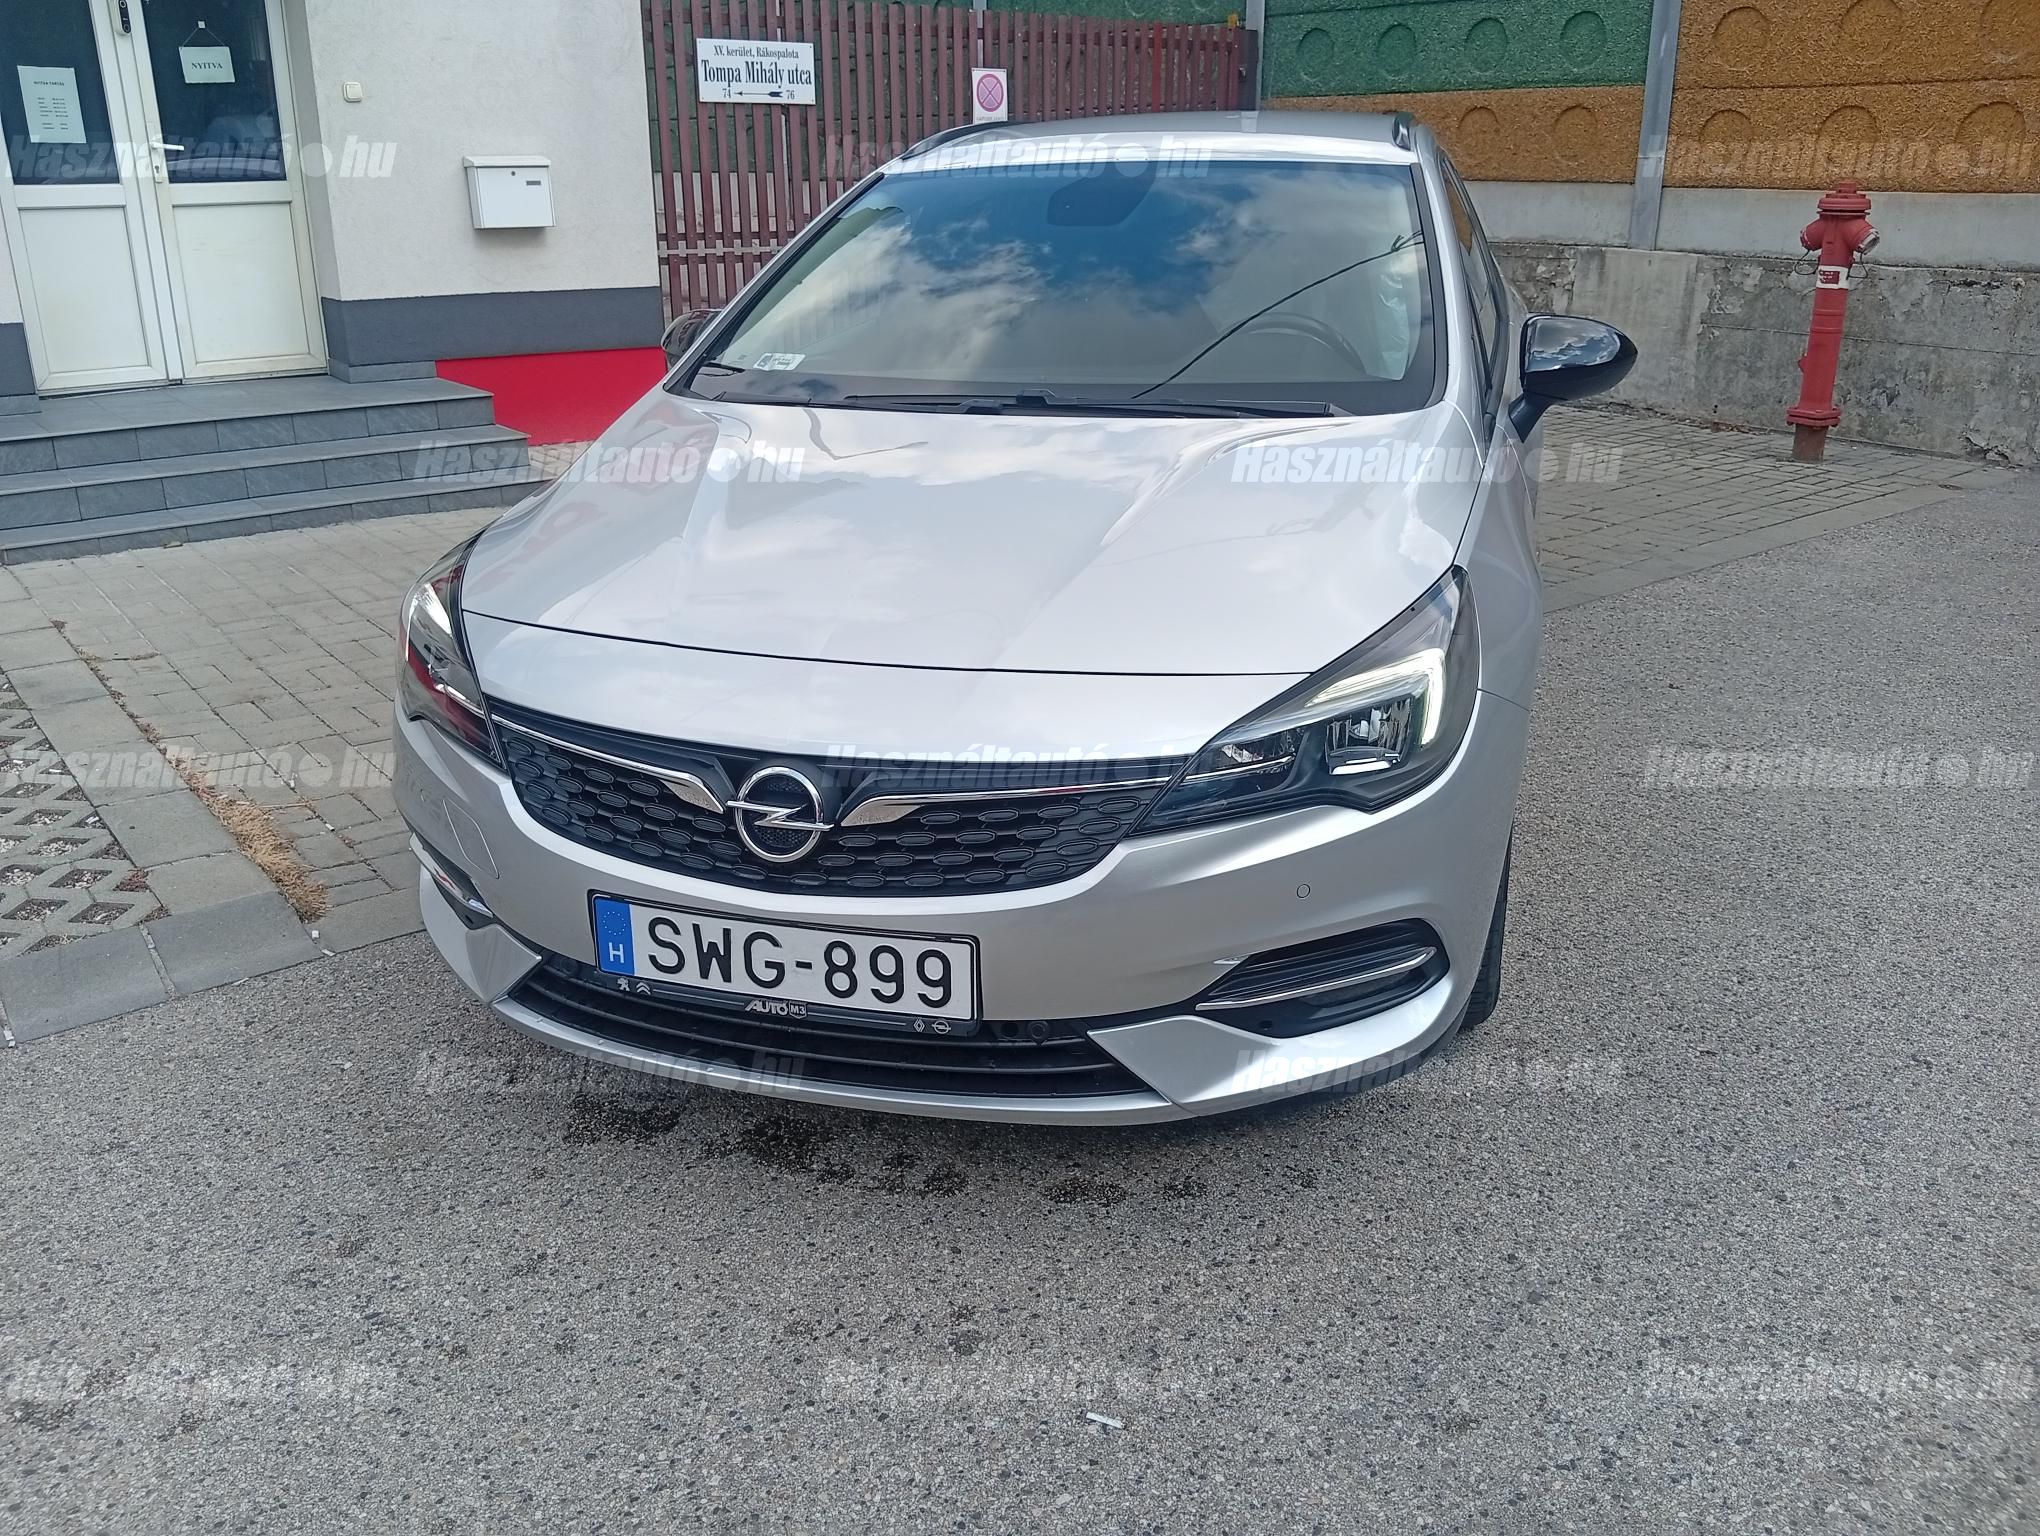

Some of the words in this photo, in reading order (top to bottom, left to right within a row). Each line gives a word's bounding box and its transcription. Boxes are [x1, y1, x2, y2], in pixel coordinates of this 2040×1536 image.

[713, 45, 725, 57] XV.
[726, 45, 755, 58] kerület,
[756, 46, 799, 60] Rákospalota
[701, 59, 742, 88] Tompa
[744, 61, 785, 89] Mihály
[787, 63, 812, 85] utca
[722, 88, 731, 98] 74
[786, 90, 795, 100] 76
[608, 941, 625, 964] H
[647, 915, 953, 1009] SWG-899
[790, 1004, 806, 1015] M3
